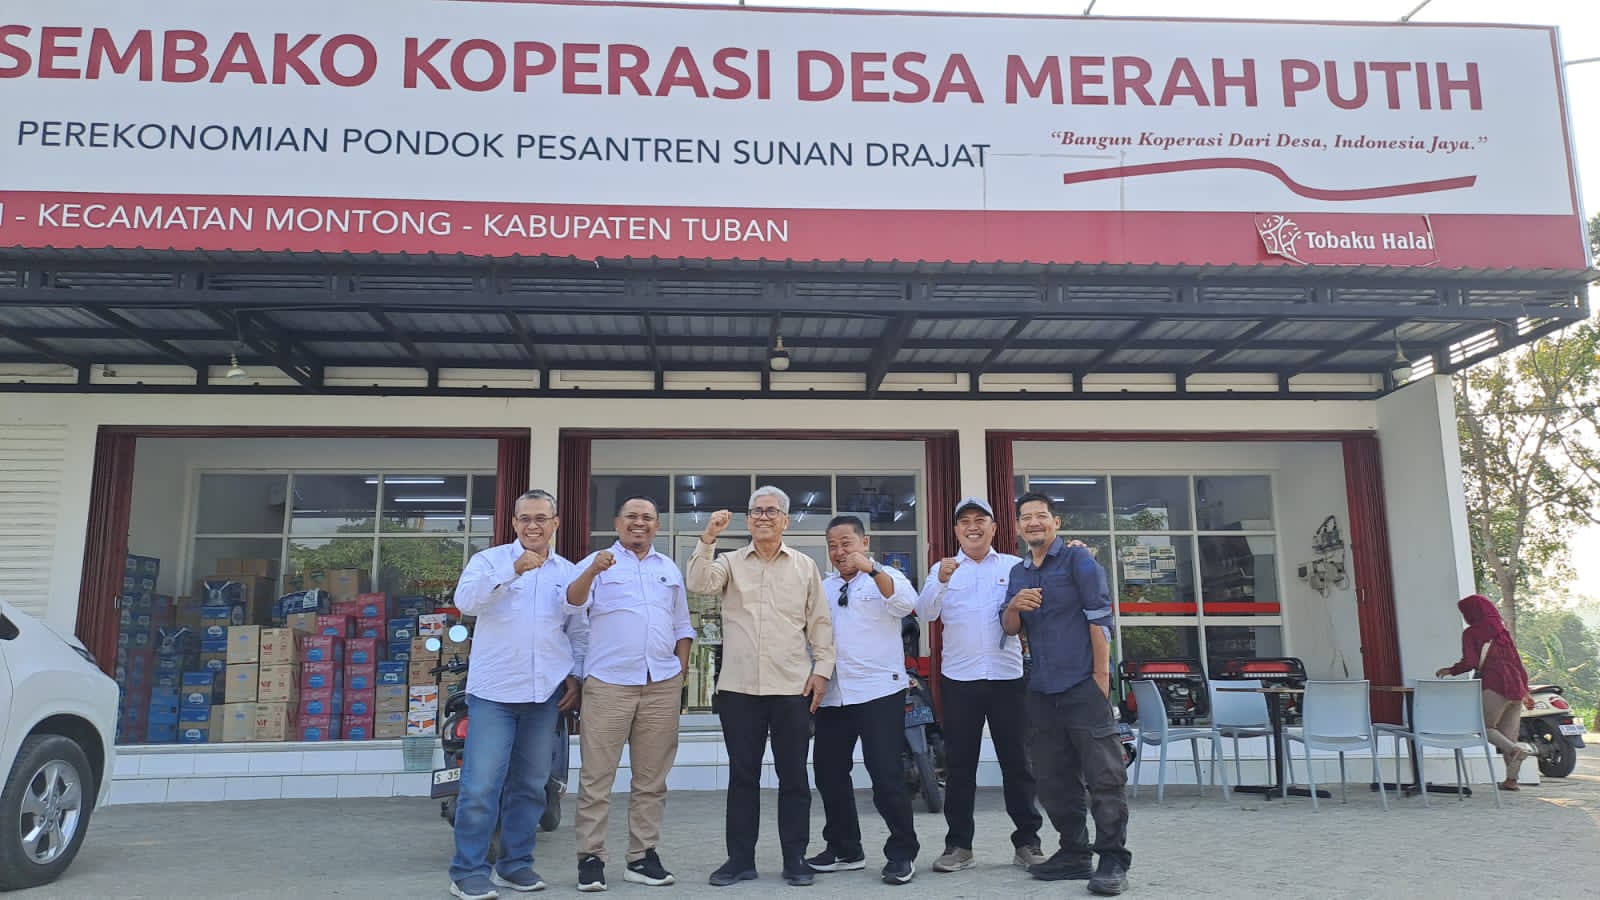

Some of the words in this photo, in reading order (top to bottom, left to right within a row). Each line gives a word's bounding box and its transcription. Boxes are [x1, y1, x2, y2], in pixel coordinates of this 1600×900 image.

[0, 25, 377, 88] SEMBAKO
[404, 38, 771, 101] KOPERASI
[798, 50, 985, 105] DESA
[1006, 55, 1258, 108] MERAH
[1281, 60, 1483, 111] PUTIH
[18, 121, 328, 153] PEREKONOMIAN
[343, 129, 505, 158] PONDOK
[517, 135, 720, 164] PESANTREN
[733, 140, 853, 166] SUNAN
[867, 143, 991, 168] DRAJAT
[1138, 132, 1223, 150] Koperasi
[1228, 133, 1271, 147] Dari
[1277, 133, 1327, 150] Desa,
[1334, 134, 1425, 149] Indonesia
[38, 204, 253, 231] KECAMATAN
[266, 208, 451, 235] MONTONG
[484, 213, 671, 241] KABUPATEN
[682, 218, 789, 242] TUBAN
[1304, 231, 1376, 250] Tobaku
[1381, 231, 1434, 250] Halal
